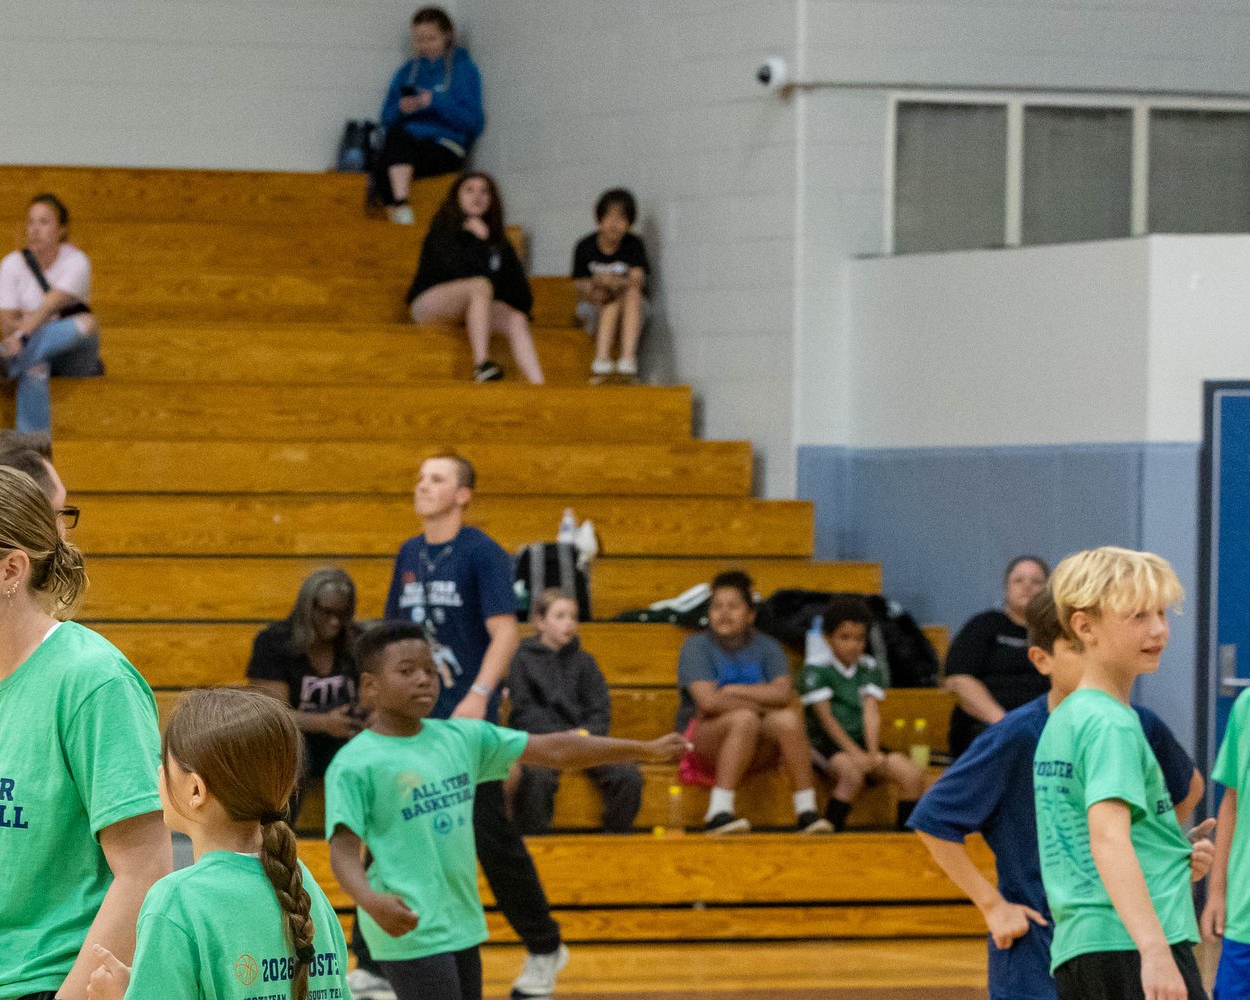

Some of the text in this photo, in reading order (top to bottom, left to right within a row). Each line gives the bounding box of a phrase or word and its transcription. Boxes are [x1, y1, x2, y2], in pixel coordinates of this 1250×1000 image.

[1033, 760, 1073, 779] OSTER
[413, 782, 441, 802] ALL
[261, 953, 340, 982] 2026 OST
[329, 988, 342, 999] TEA
